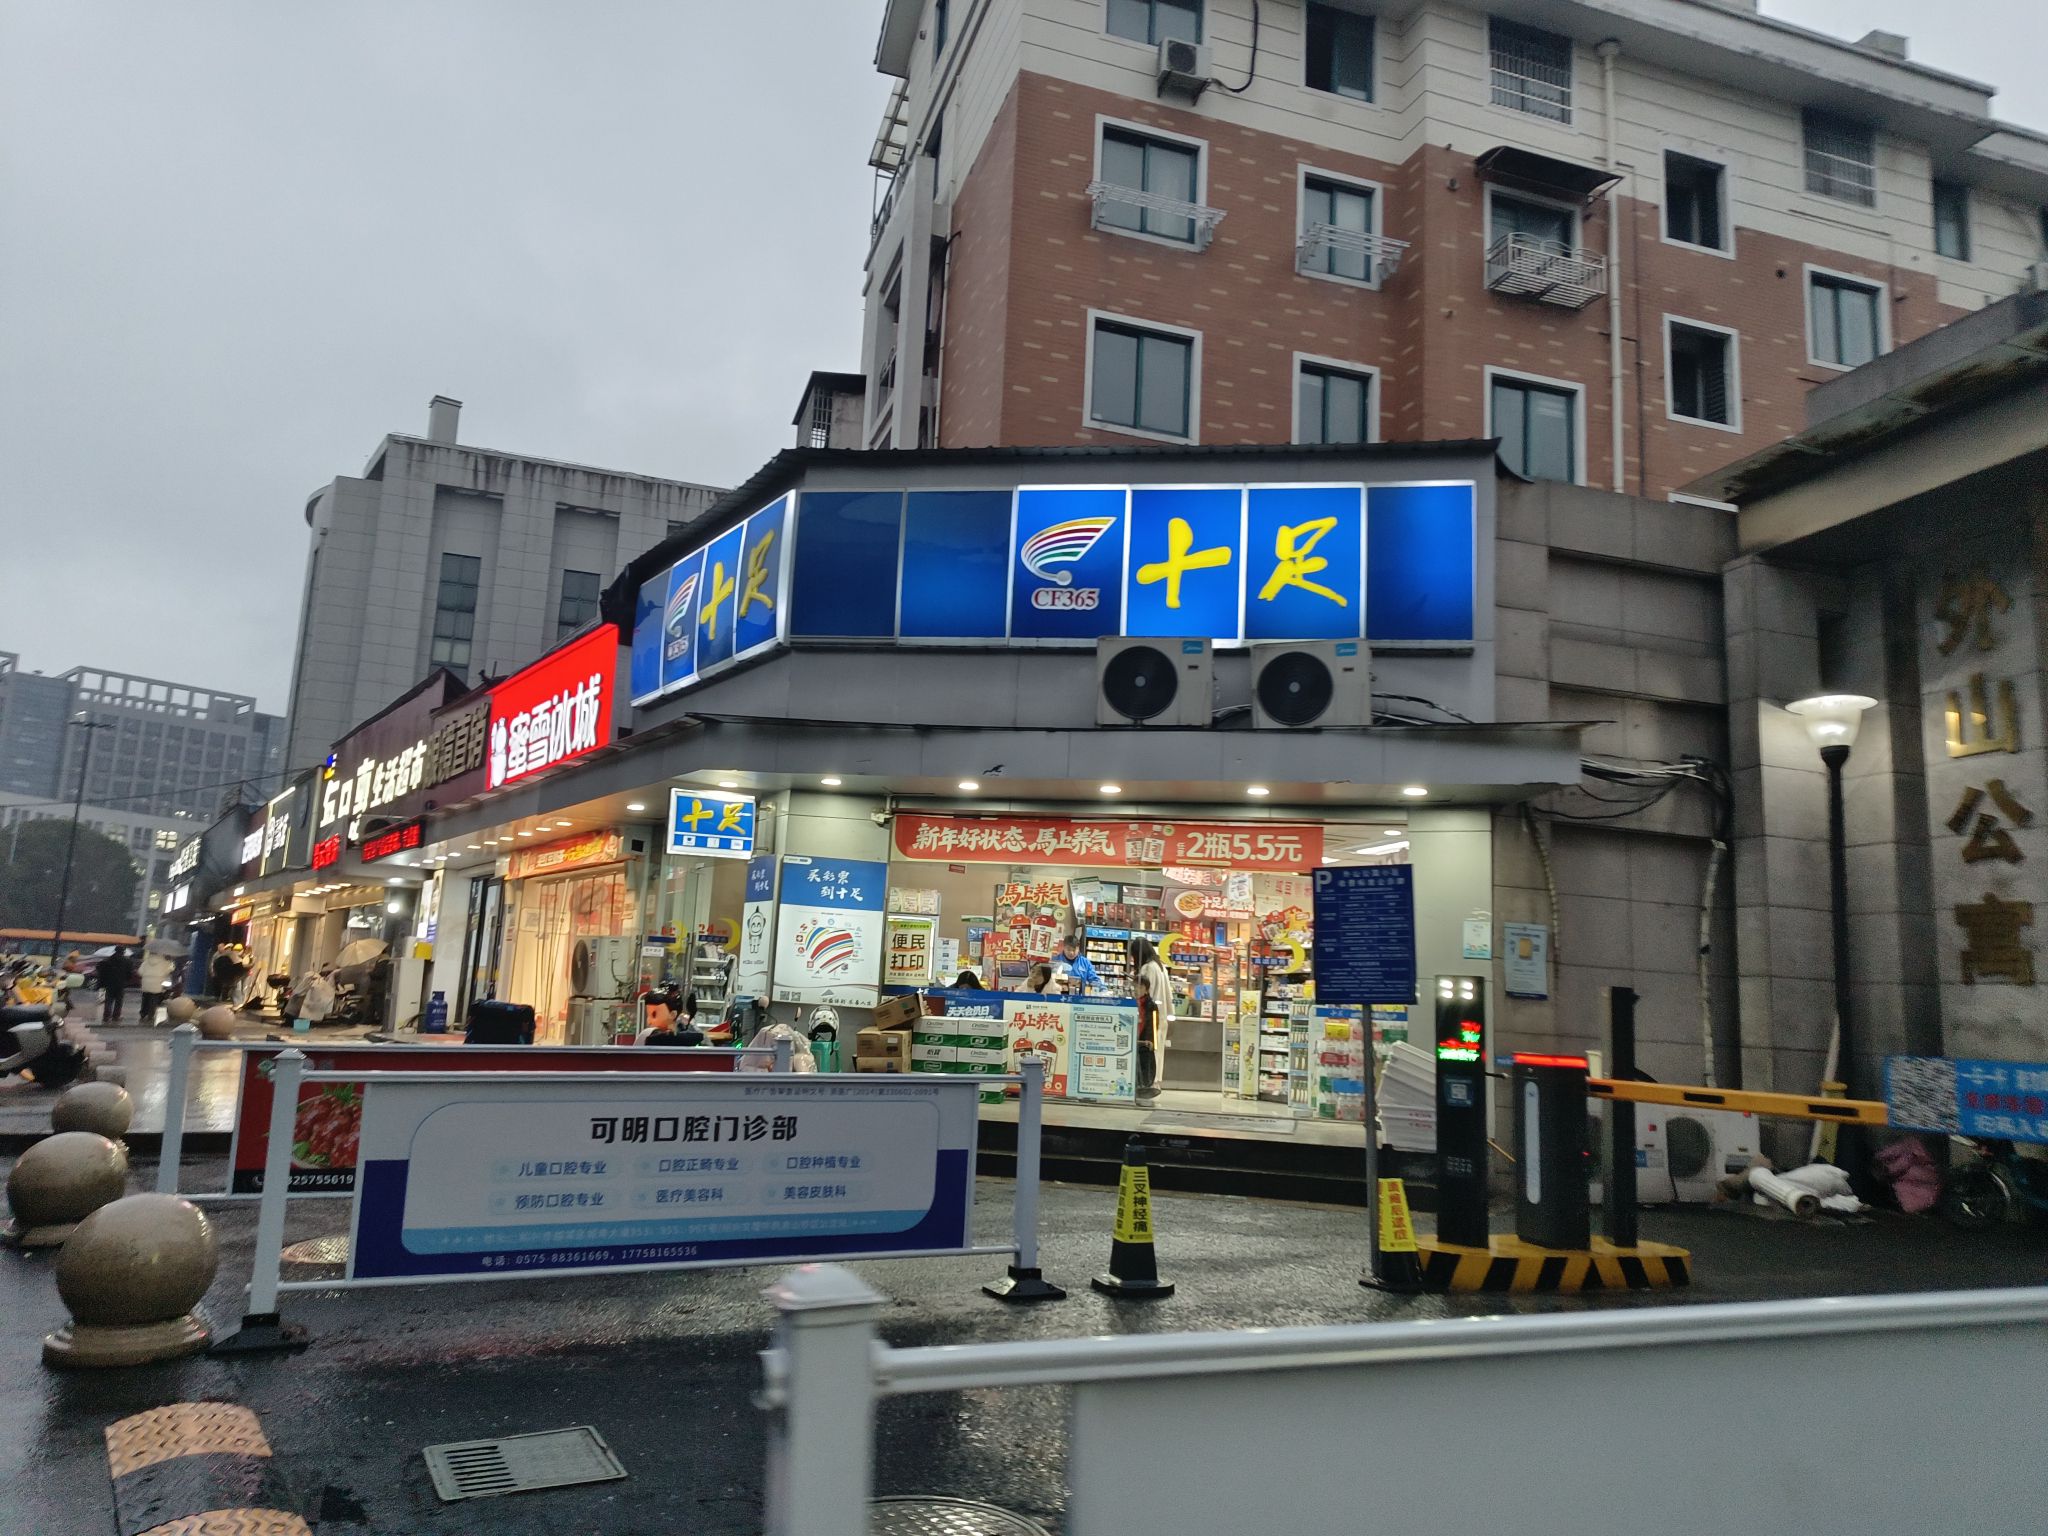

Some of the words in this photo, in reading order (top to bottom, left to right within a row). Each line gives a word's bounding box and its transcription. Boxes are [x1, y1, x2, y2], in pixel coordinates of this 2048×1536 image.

[1136, 517, 1348, 607] 十足
[1032, 588, 1098, 610] CF365
[507, 673, 602, 779] 蜜雪冰城
[682, 799, 746, 835] 十足
[912, 823, 1026, 852] 新年好状态
[1187, 832, 1303, 862] 2瓶5.5元
[807, 869, 850, 885] 买彩票
[1315, 870, 1333, 893] P
[820, 887, 863, 901] 到十足
[892, 933, 925, 950] 便民
[890, 953, 924, 969] 打印
[590, 1115, 799, 1144] 可明口腔门诊部
[518, 1159, 607, 1177] 儿童口腔专业
[786, 1154, 861, 1170] 口腔种植专业
[514, 1192, 604, 1209] 预防口腔专业
[655, 1187, 724, 1204] 医疗美容科
[783, 1184, 846, 1200] 美容皮肤科
[1133, 1171, 1148, 1232] 三叉神经痛
